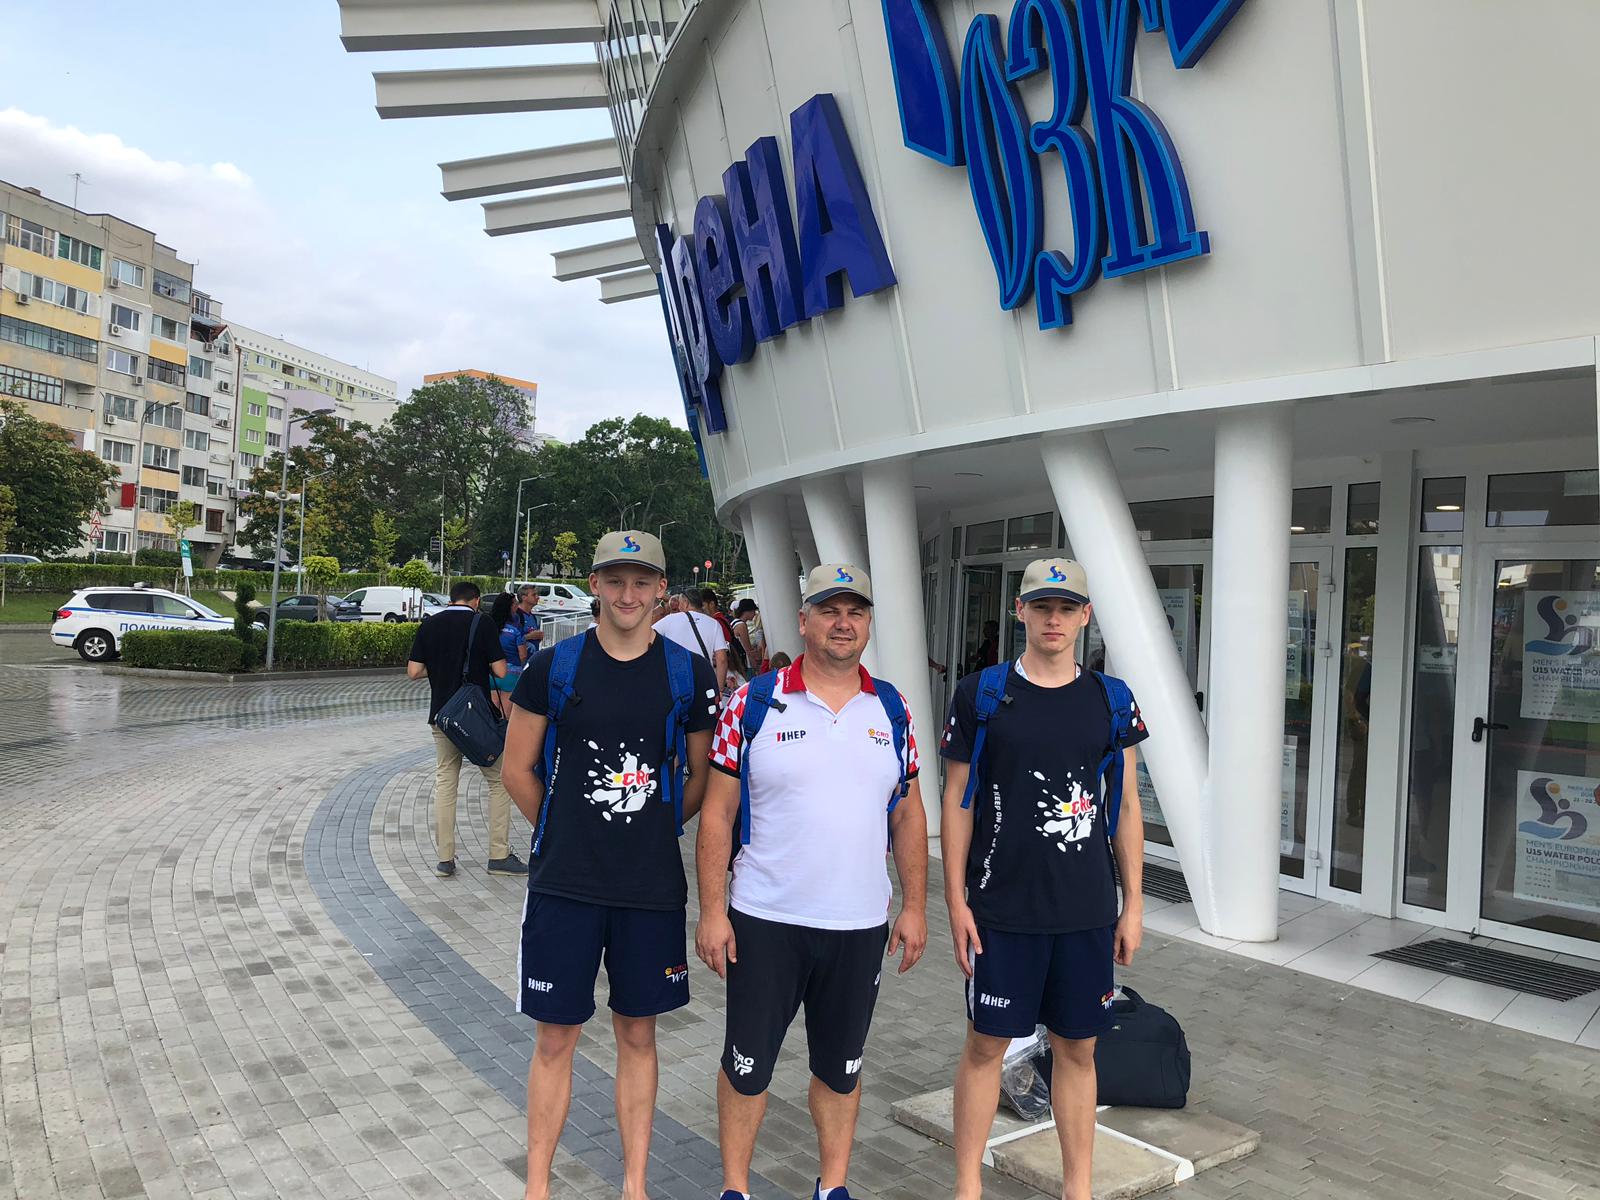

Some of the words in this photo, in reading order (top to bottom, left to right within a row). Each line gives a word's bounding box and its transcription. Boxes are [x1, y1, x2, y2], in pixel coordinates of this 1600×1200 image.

[1532, 666, 1549, 674] U15
[787, 730, 806, 741] HEP
[876, 731, 889, 739] CRO
[1526, 848, 1542, 856] U15
[1543, 850, 1576, 861] WATER
[535, 980, 553, 992] HEP
[990, 995, 1011, 1008] HEP
